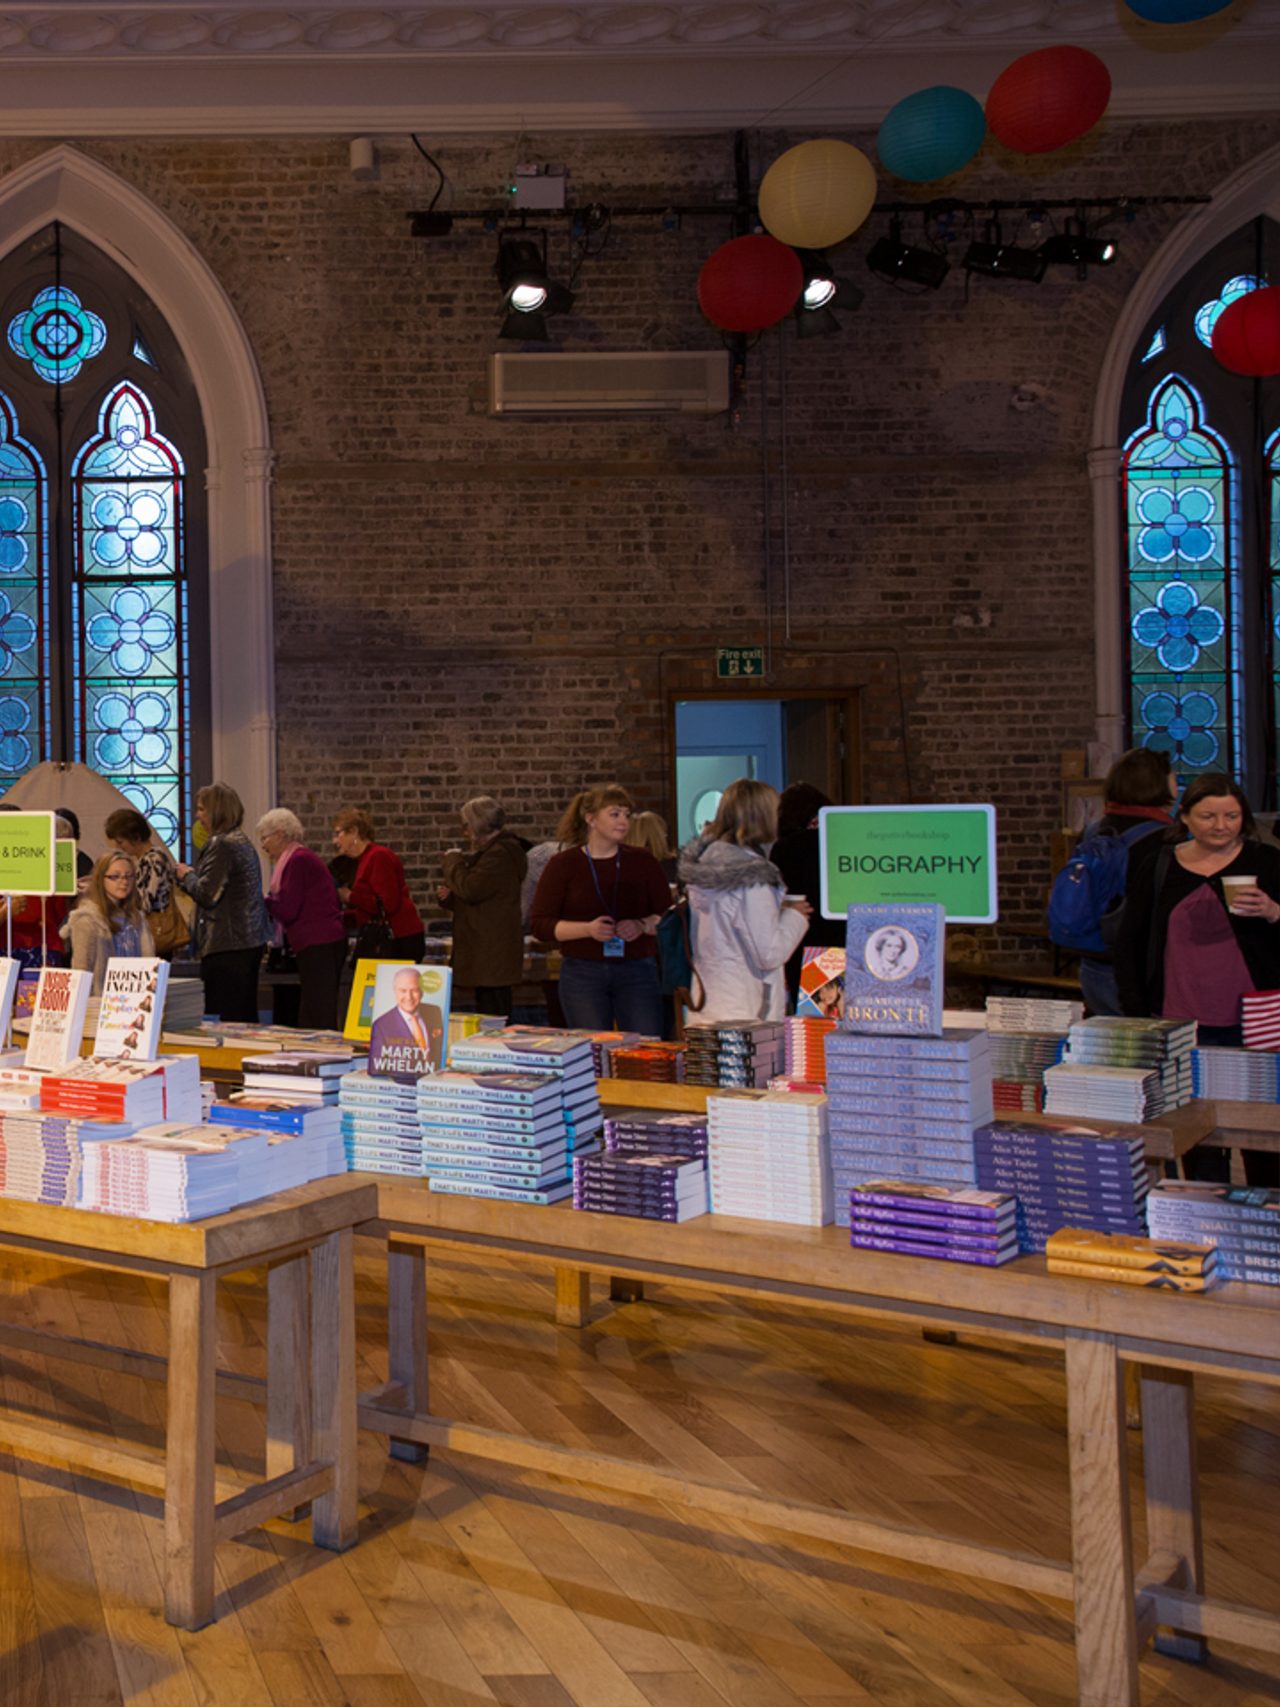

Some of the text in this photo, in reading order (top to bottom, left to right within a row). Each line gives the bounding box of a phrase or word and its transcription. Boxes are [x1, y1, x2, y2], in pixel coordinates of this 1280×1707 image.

[720, 649, 762, 660] Fire exit
[2, 847, 9, 858] &
[12, 846, 47, 859] DRINK
[838, 855, 983, 874] BIOGRAPHY
[380, 1045, 431, 1061] MARTY
[516, 1054, 544, 1063] WHELAN
[373, 1057, 435, 1074] WHELAN
[421, 1084, 444, 1093] THAT'S
[461, 1088, 483, 1097] MARTY
[485, 1091, 514, 1099] WHELAN
[421, 1099, 443, 1107] THAT'S
[460, 1103, 483, 1111] MARTY
[485, 1105, 514, 1114] WHELAN
[461, 1118, 484, 1126] MARTY
[486, 1120, 516, 1129] WHELAN
[463, 1131, 486, 1139] MARTY
[487, 1133, 516, 1142] WHELAN
[989, 1132, 1009, 1142] Alice
[1011, 1134, 1036, 1144] Taylor
[467, 1145, 490, 1153] MARTY
[492, 1147, 522, 1156] WHELAN
[991, 1145, 1010, 1154] Alice
[1012, 1147, 1037, 1156] Taylor
[427, 1155, 449, 1163] THAT'S
[467, 1159, 490, 1167] MARTY
[492, 1161, 522, 1170] WHELAN
[992, 1157, 1012, 1166] Alice
[1014, 1159, 1038, 1169] Taylor
[489, 1175, 518, 1184] WHELAN
[994, 1169, 1013, 1178] Alice
[1015, 1171, 1040, 1180] Taylor
[433, 1182, 456, 1191] THAT'S
[473, 1188, 497, 1196] MARTY
[498, 1190, 528, 1200] WHELAN
[995, 1180, 1014, 1189] Alice
[1016, 1182, 1041, 1192] Taylor
[1018, 1194, 1042, 1204] Taylor
